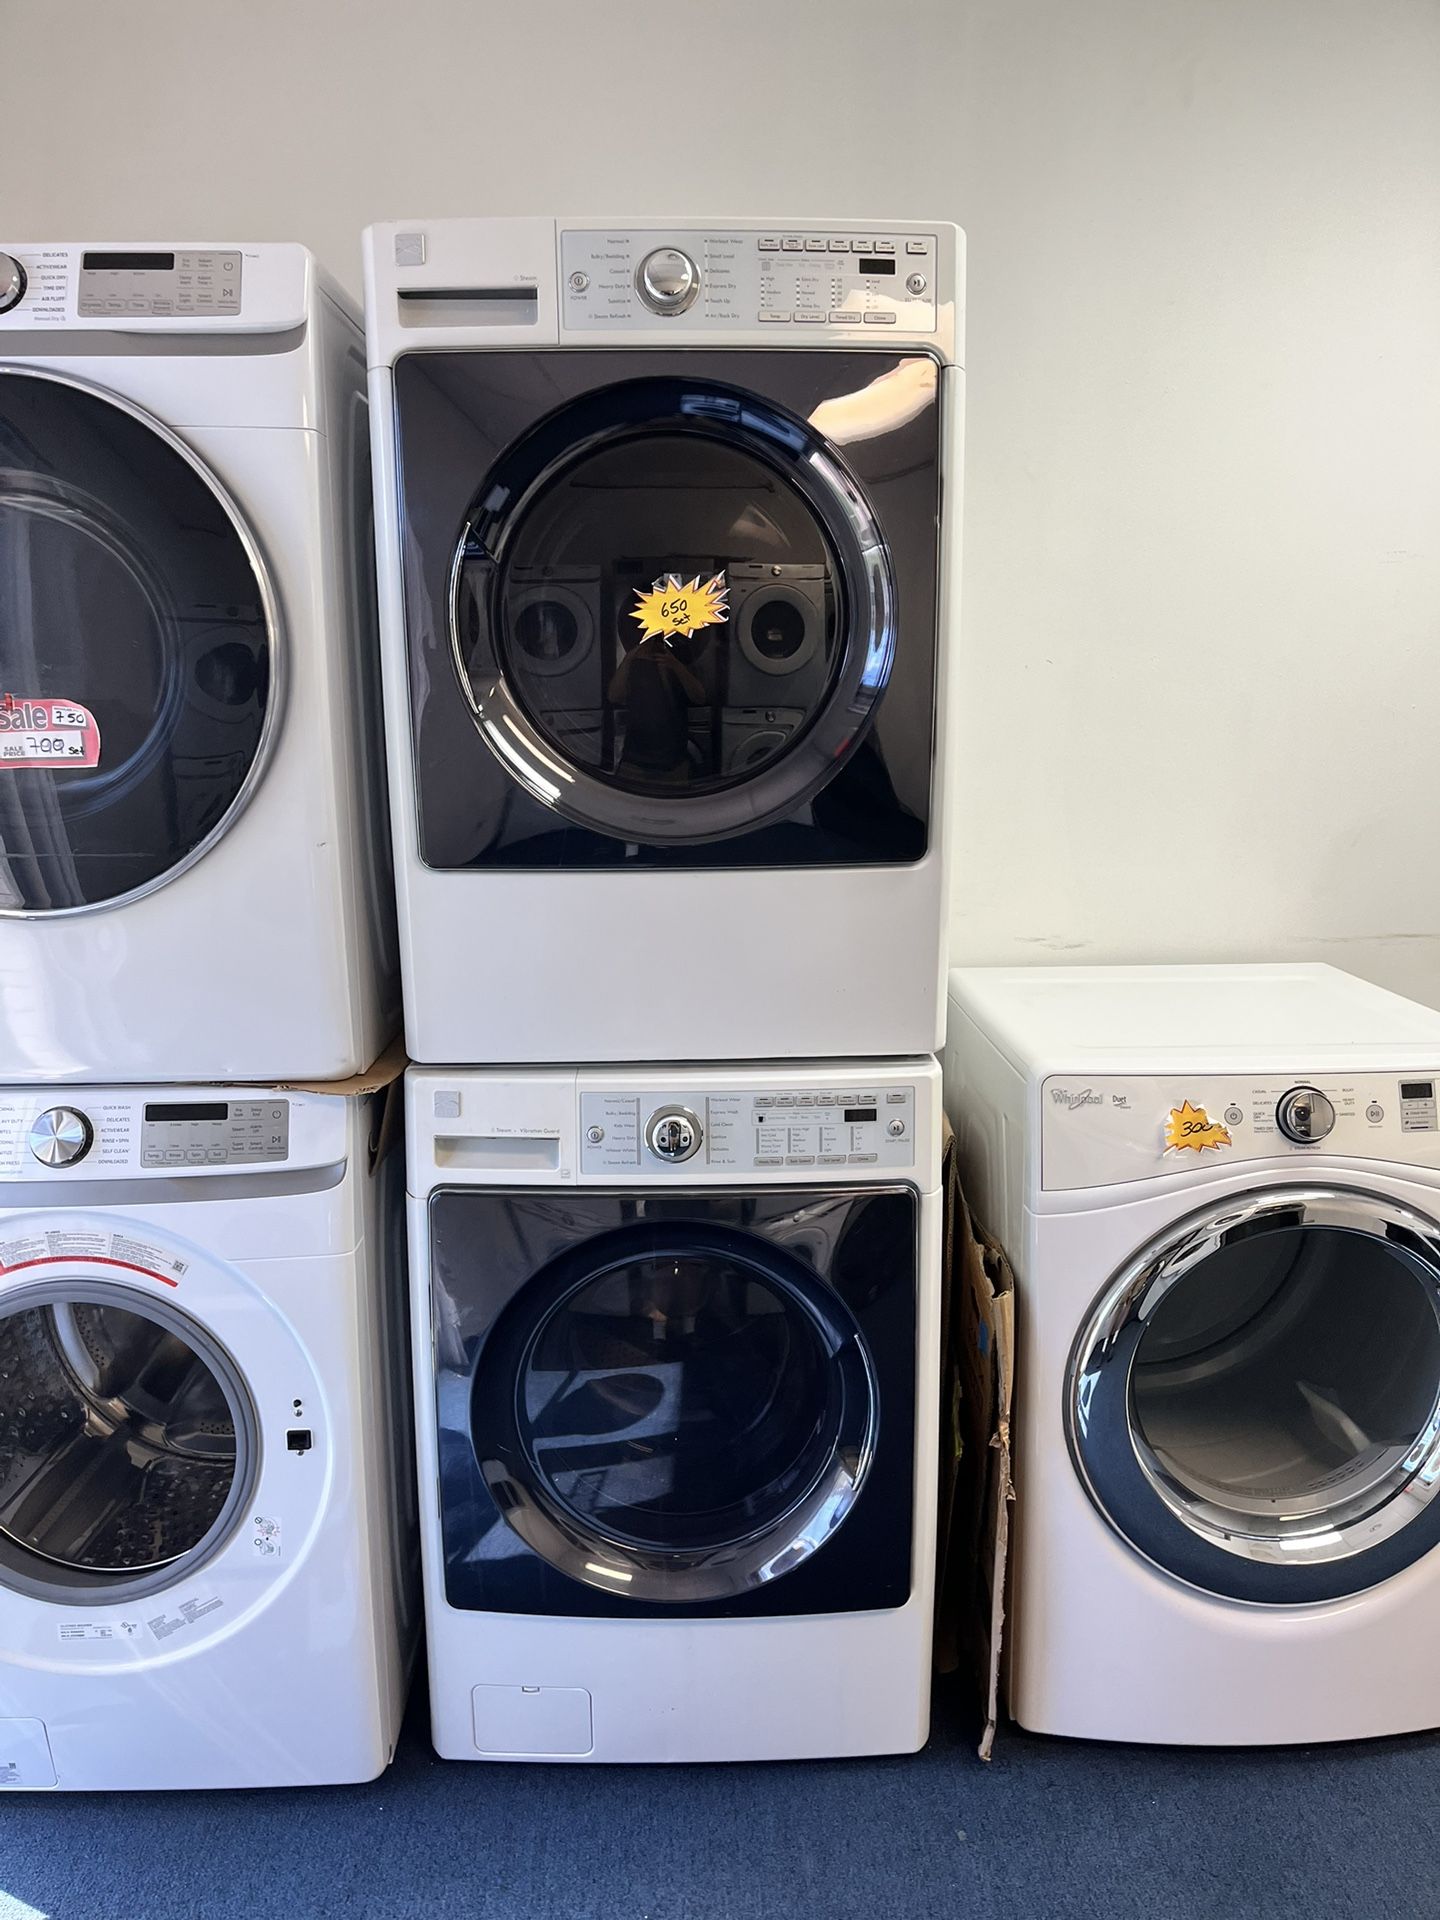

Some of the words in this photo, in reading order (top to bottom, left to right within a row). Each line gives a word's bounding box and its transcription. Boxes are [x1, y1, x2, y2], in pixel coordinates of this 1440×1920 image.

[660, 598, 688, 618] 650
[55, 710, 85, 724] 750
[1051, 1088, 1104, 1110] Whirlpool
